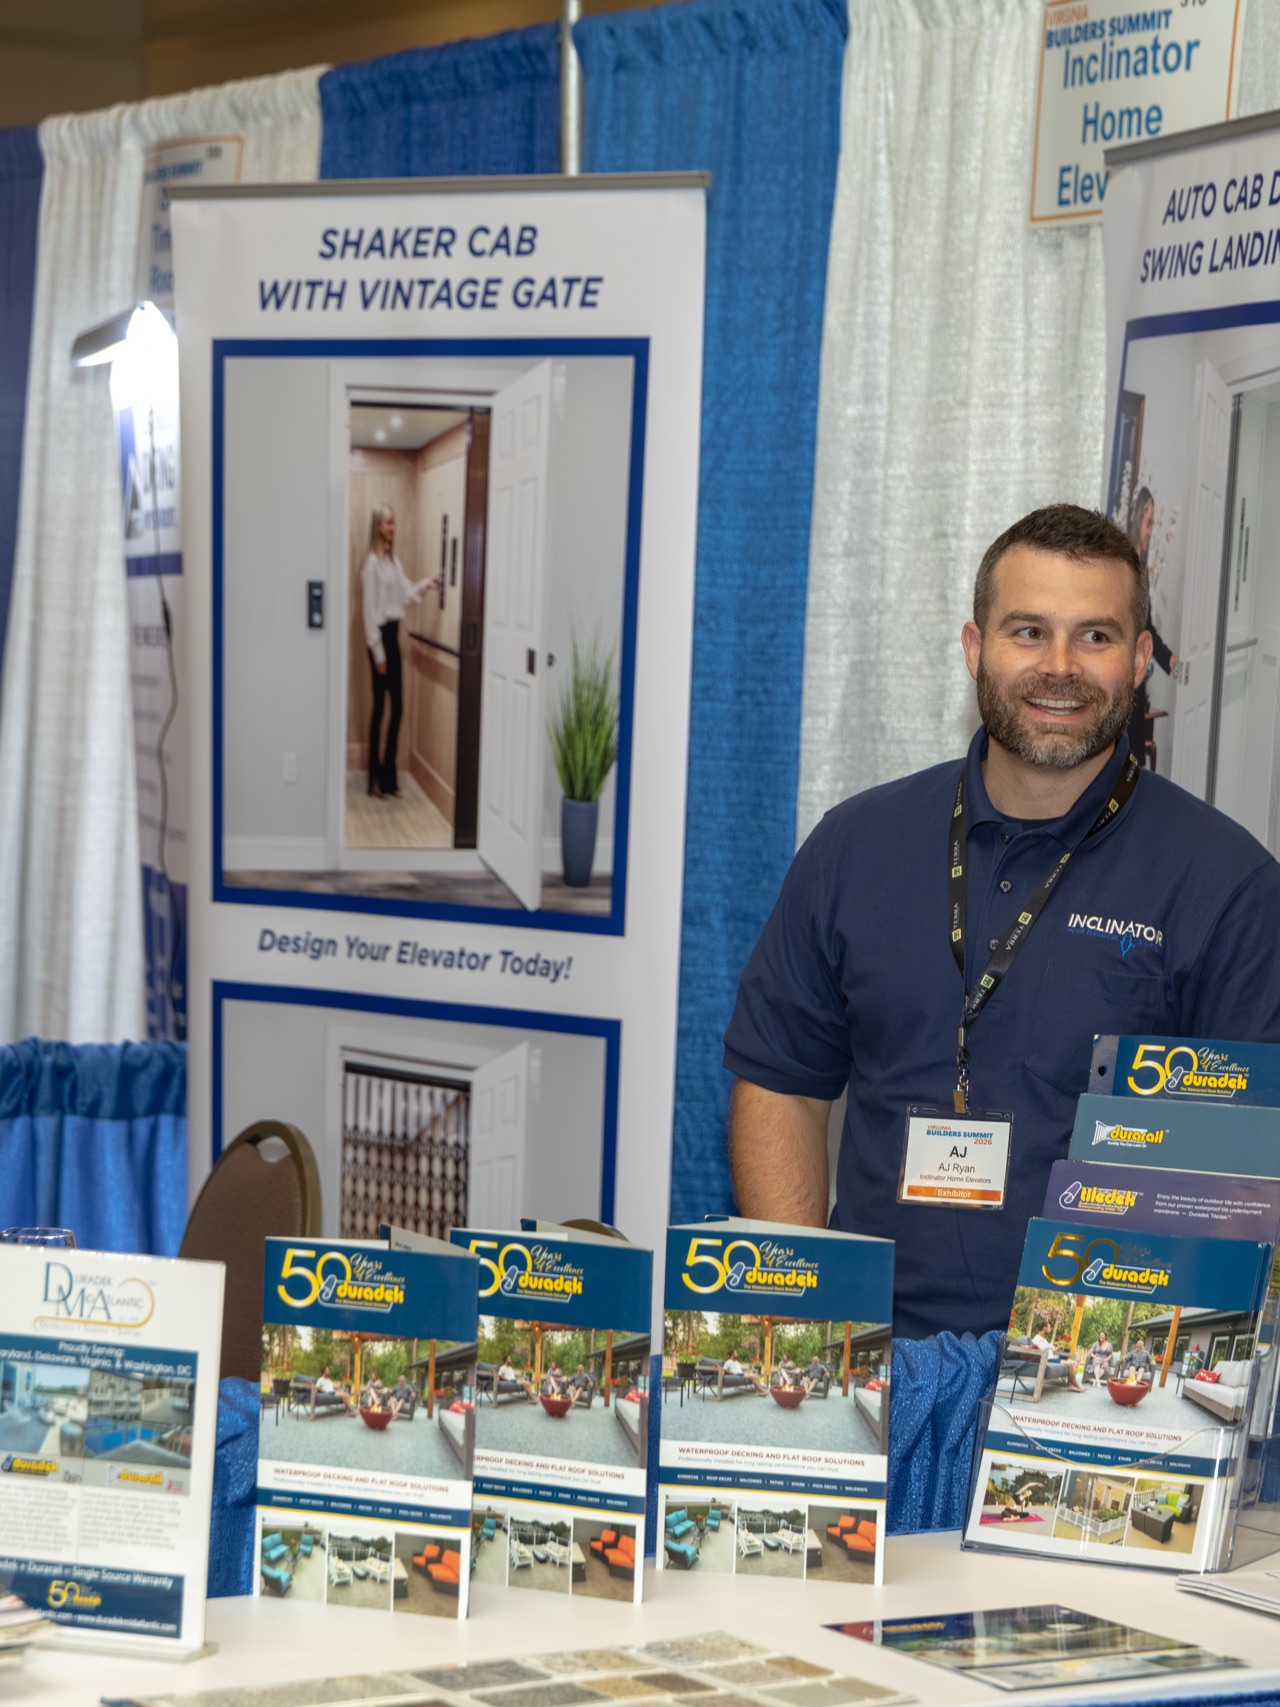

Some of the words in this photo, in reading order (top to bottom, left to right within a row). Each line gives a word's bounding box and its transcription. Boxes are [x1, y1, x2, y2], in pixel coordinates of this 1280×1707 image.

[1046, 20, 1105, 48] BUILDERS
[1108, 9, 1173, 37] SUMMIT
[1063, 35, 1200, 89] Inclinator
[1081, 103, 1162, 144] Home
[1162, 181, 1217, 226] AUTO
[1223, 169, 1264, 214] CAB
[318, 226, 457, 260] SHAKER
[468, 225, 539, 259] CAB
[1140, 240, 1204, 284] SWING
[259, 279, 347, 312] WITH
[359, 278, 502, 311] VINTAGE
[511, 275, 603, 310] GATE
[1005, 924, 1024, 950] TERRA
[1068, 913, 1163, 947] INCLINATOR
[258, 928, 338, 961] Design
[345, 935, 392, 963] Your
[395, 941, 491, 972] Elevator
[499, 951, 574, 983] Today!
[1197, 1046, 1229, 1065] Years
[1211, 1060, 1250, 1073] Excellence
[1127, 1044, 1198, 1096] 50
[1182, 1070, 1248, 1090] duradek
[926, 1129, 962, 1138] BUILDERS
[963, 1131, 994, 1139] SUMMIT
[973, 1137, 993, 1146] 2026
[949, 1145, 968, 1159] AJ
[919, 1173, 946, 1181] Inclinator
[947, 1175, 964, 1183] Home
[965, 1176, 992, 1185] Elevators
[938, 1162, 950, 1172] AJ
[952, 1163, 976, 1175] Ryan
[937, 1188, 972, 1199] Exhibitor
[1080, 1186, 1137, 1208] tiledek
[1157, 1193, 1171, 1202] Enjoy
[1180, 1195, 1197, 1204] beauty
[1204, 1197, 1224, 1205] outdoor
[1244, 1200, 1271, 1209] confidence
[1153, 1208, 1180, 1216] membrane
[1155, 1200, 1168, 1208] from
[1176, 1202, 1194, 1210] proven
[1194, 1203, 1221, 1213] waterproof
[530, 1244, 563, 1263] Years
[759, 1240, 795, 1260] Years
[1042, 1231, 1120, 1287] 50
[350, 1252, 383, 1271] Years
[468, 1239, 533, 1298] 50
[545, 1259, 585, 1276] Excellence
[681, 1237, 761, 1294] 50
[775, 1254, 819, 1269] Excellence
[277, 1248, 353, 1309] 50
[518, 1270, 583, 1295] duradek
[745, 1267, 818, 1289] duradek
[1102, 1264, 1169, 1287] duradek
[336, 1280, 405, 1304] duradek
[59, 1340, 91, 1354] Proudly
[177, 1365, 192, 1377] DC
[1012, 1414, 1060, 1427] WATERPROOF
[1062, 1420, 1091, 1431] DECKING
[1093, 1424, 1107, 1433] AND
[1108, 1426, 1124, 1435] FLAT
[1125, 1428, 1144, 1437] ROOF
[1146, 1431, 1182, 1442] SOLUTIONS
[678, 1446, 730, 1457] WATERPROOF
[731, 1450, 764, 1460] DECKING
[765, 1452, 781, 1461] AND
[783, 1453, 800, 1462] FLAT
[802, 1455, 822, 1464] ROOF
[824, 1456, 866, 1467] SOLUTIONS
[274, 1467, 322, 1480] WATERPROOF
[323, 1472, 354, 1483] DECKING
[355, 1475, 370, 1485] AND
[371, 1477, 388, 1486] FLAT
[389, 1479, 409, 1489] ROOF
[410, 1481, 449, 1493] SOLUTIONS
[505, 1458, 534, 1469] DECKING
[535, 1462, 551, 1471] AND
[552, 1464, 567, 1473] FLAT
[568, 1466, 587, 1475] ROOF
[588, 1468, 625, 1480] SOLUTIONS
[72, 1565, 101, 1581] Single
[102, 1568, 132, 1582] Source
[132, 1573, 174, 1591] Warranty
